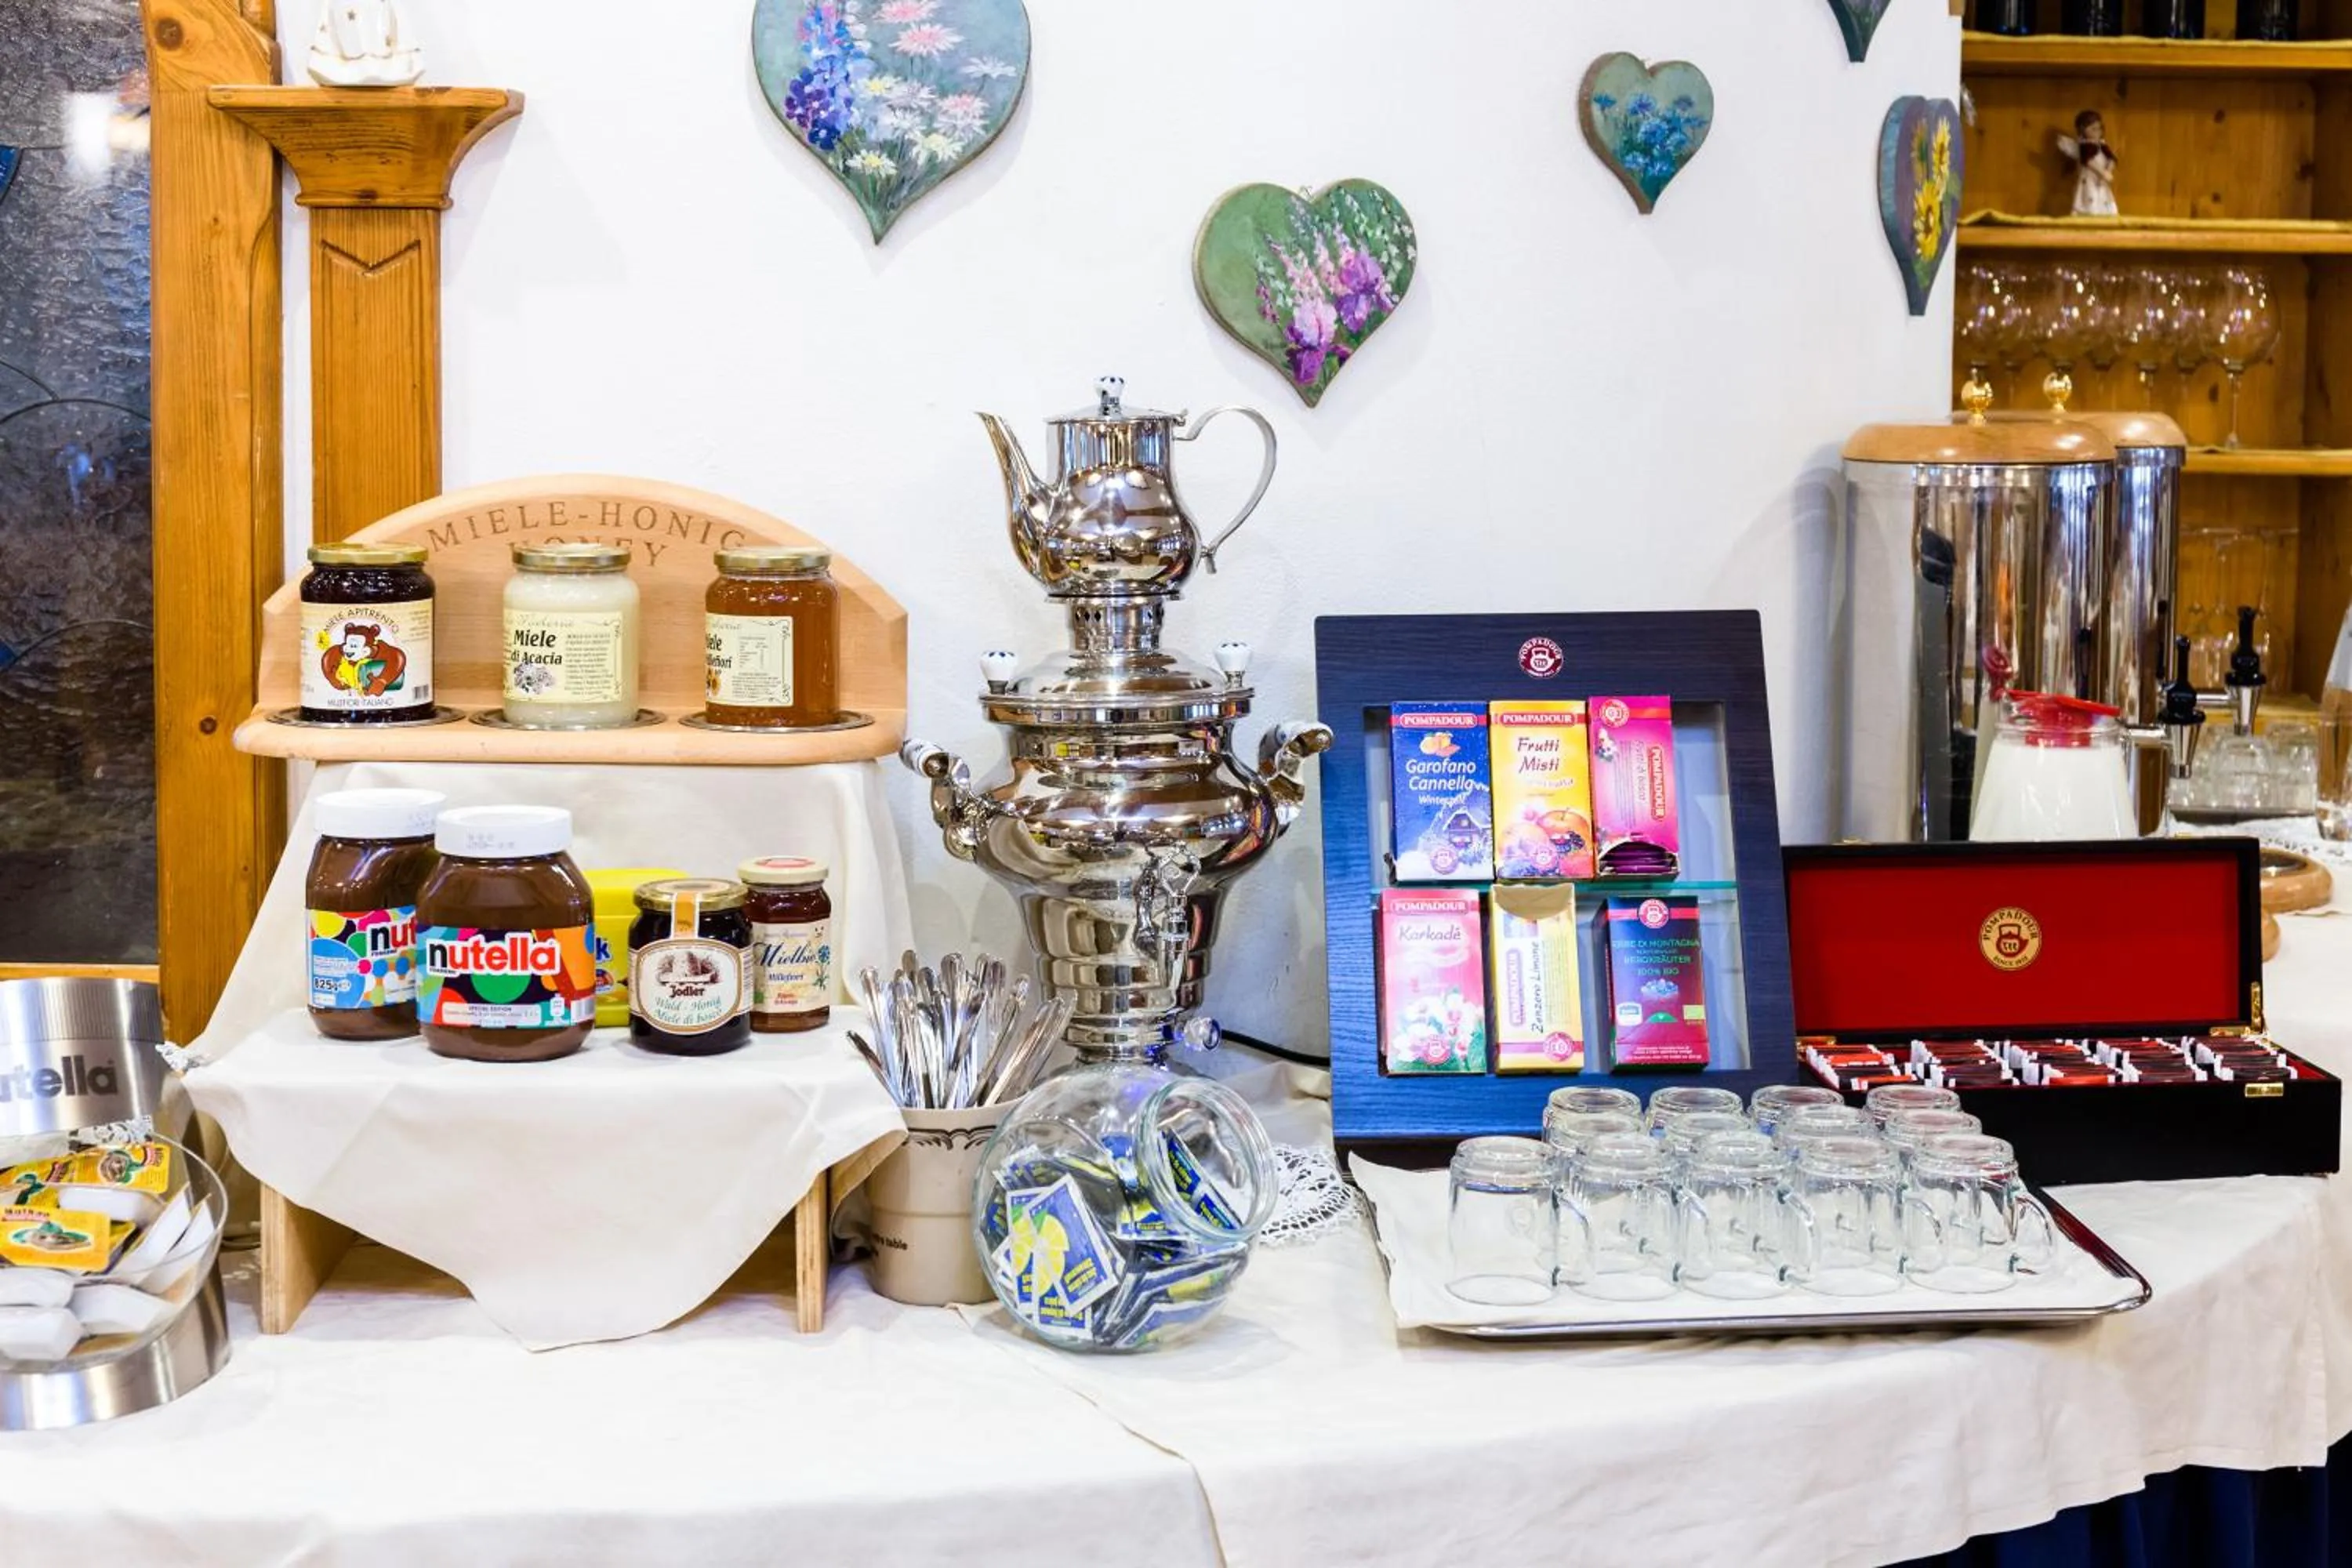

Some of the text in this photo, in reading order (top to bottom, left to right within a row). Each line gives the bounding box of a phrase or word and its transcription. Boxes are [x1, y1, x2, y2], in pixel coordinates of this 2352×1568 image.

[427, 502, 746, 552] MIELE-HONIG
[514, 629, 557, 648] Miele
[706, 633, 722, 652] iele
[510, 649, 562, 666] di Acacia
[1404, 716, 1474, 725] POMPADOUR
[1503, 714, 1572, 723] POMPADOUR
[1517, 737, 1559, 752] Frutti
[1406, 757, 1476, 774] Garofano
[1519, 756, 1560, 773] Misti
[1409, 775, 1474, 791] Cannella
[1652, 748, 1665, 816] POMPADOUR
[1983, 910, 2038, 940] POMPADOUR
[429, 937, 556, 971] nutella
[670, 985, 705, 998] Jodler
[1530, 942, 1544, 1033] Zenzero Limone
[655, 996, 722, 1011] Wald Honig
[654, 1008, 722, 1024] Miele di bosco
